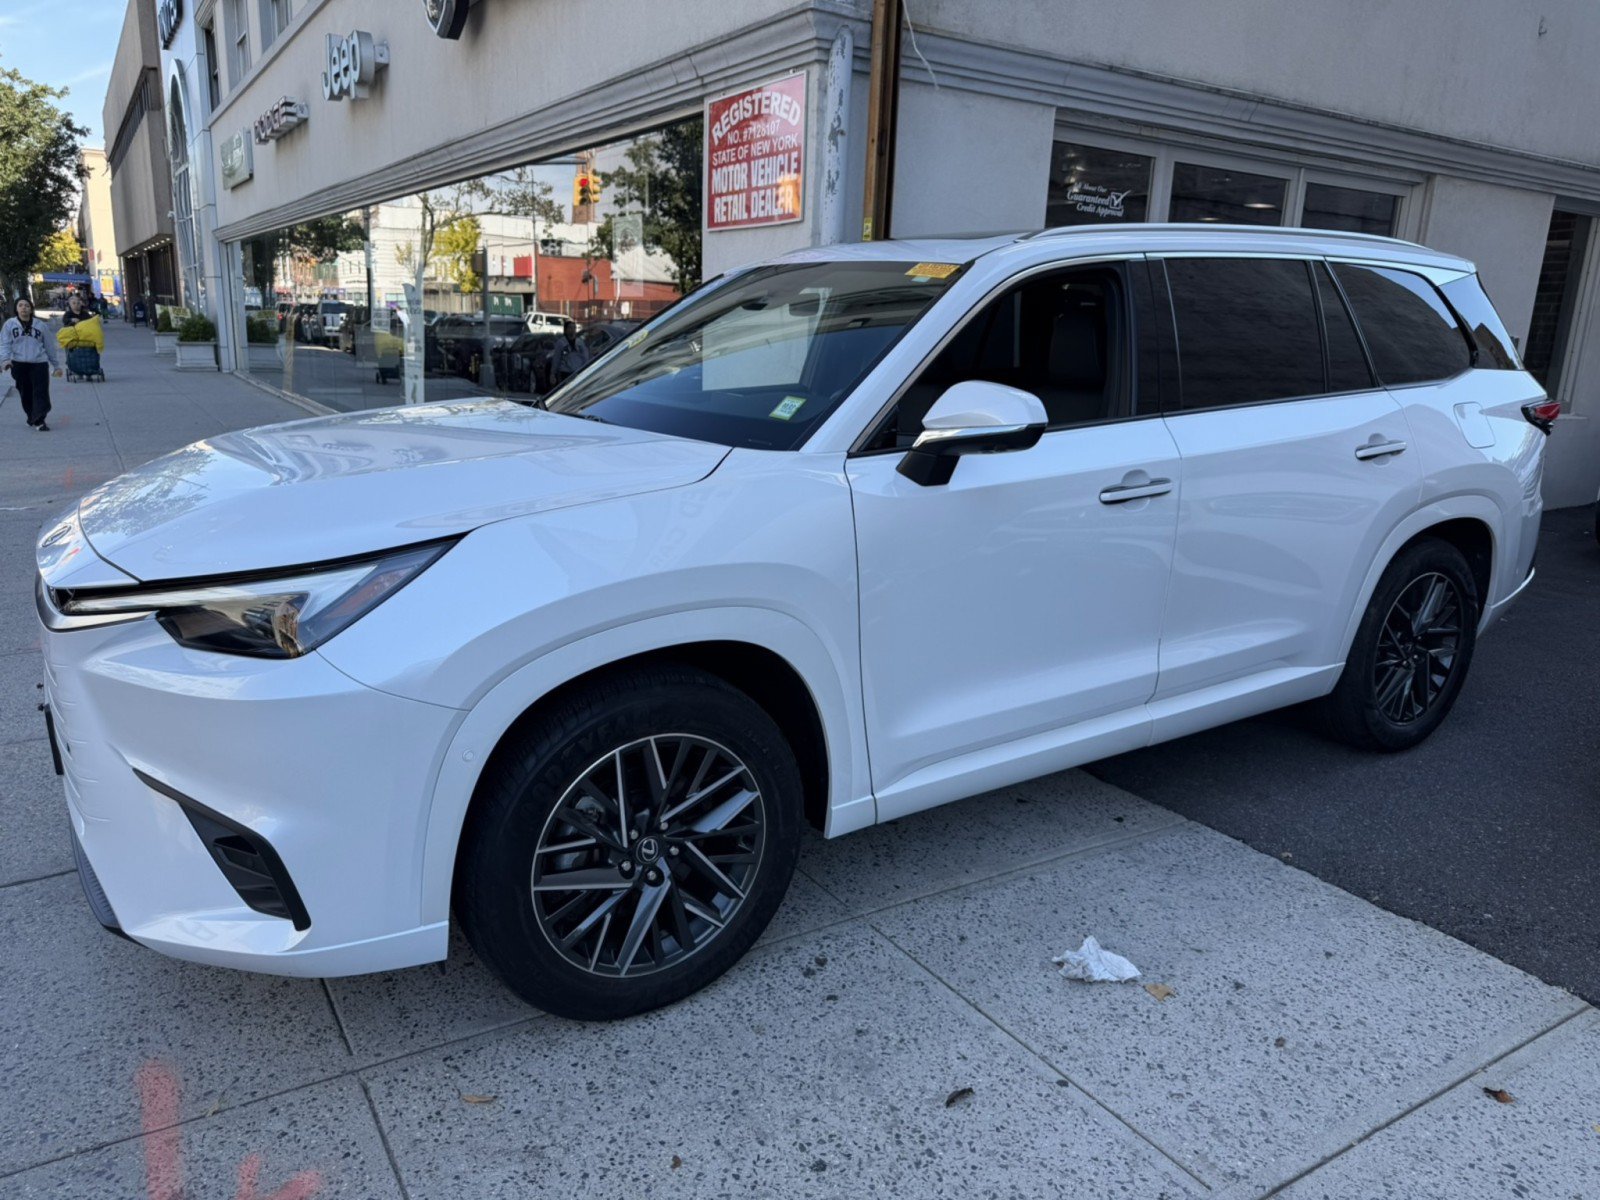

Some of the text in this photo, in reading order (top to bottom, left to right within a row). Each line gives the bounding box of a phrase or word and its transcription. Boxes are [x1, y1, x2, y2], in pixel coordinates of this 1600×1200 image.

[321, 29, 370, 101] Jeep
[254, 95, 296, 145] DODGE
[712, 92, 800, 145] REGISTERED
[727, 129, 741, 146] NO.
[712, 132, 799, 166] STATE OF NEW YORK
[712, 151, 799, 195] MOTOR VEHICLE
[714, 184, 794, 224] RETAIL DEALER
[1067, 190, 1110, 205] Guaranteed
[1076, 202, 1124, 217] Credit Approval
